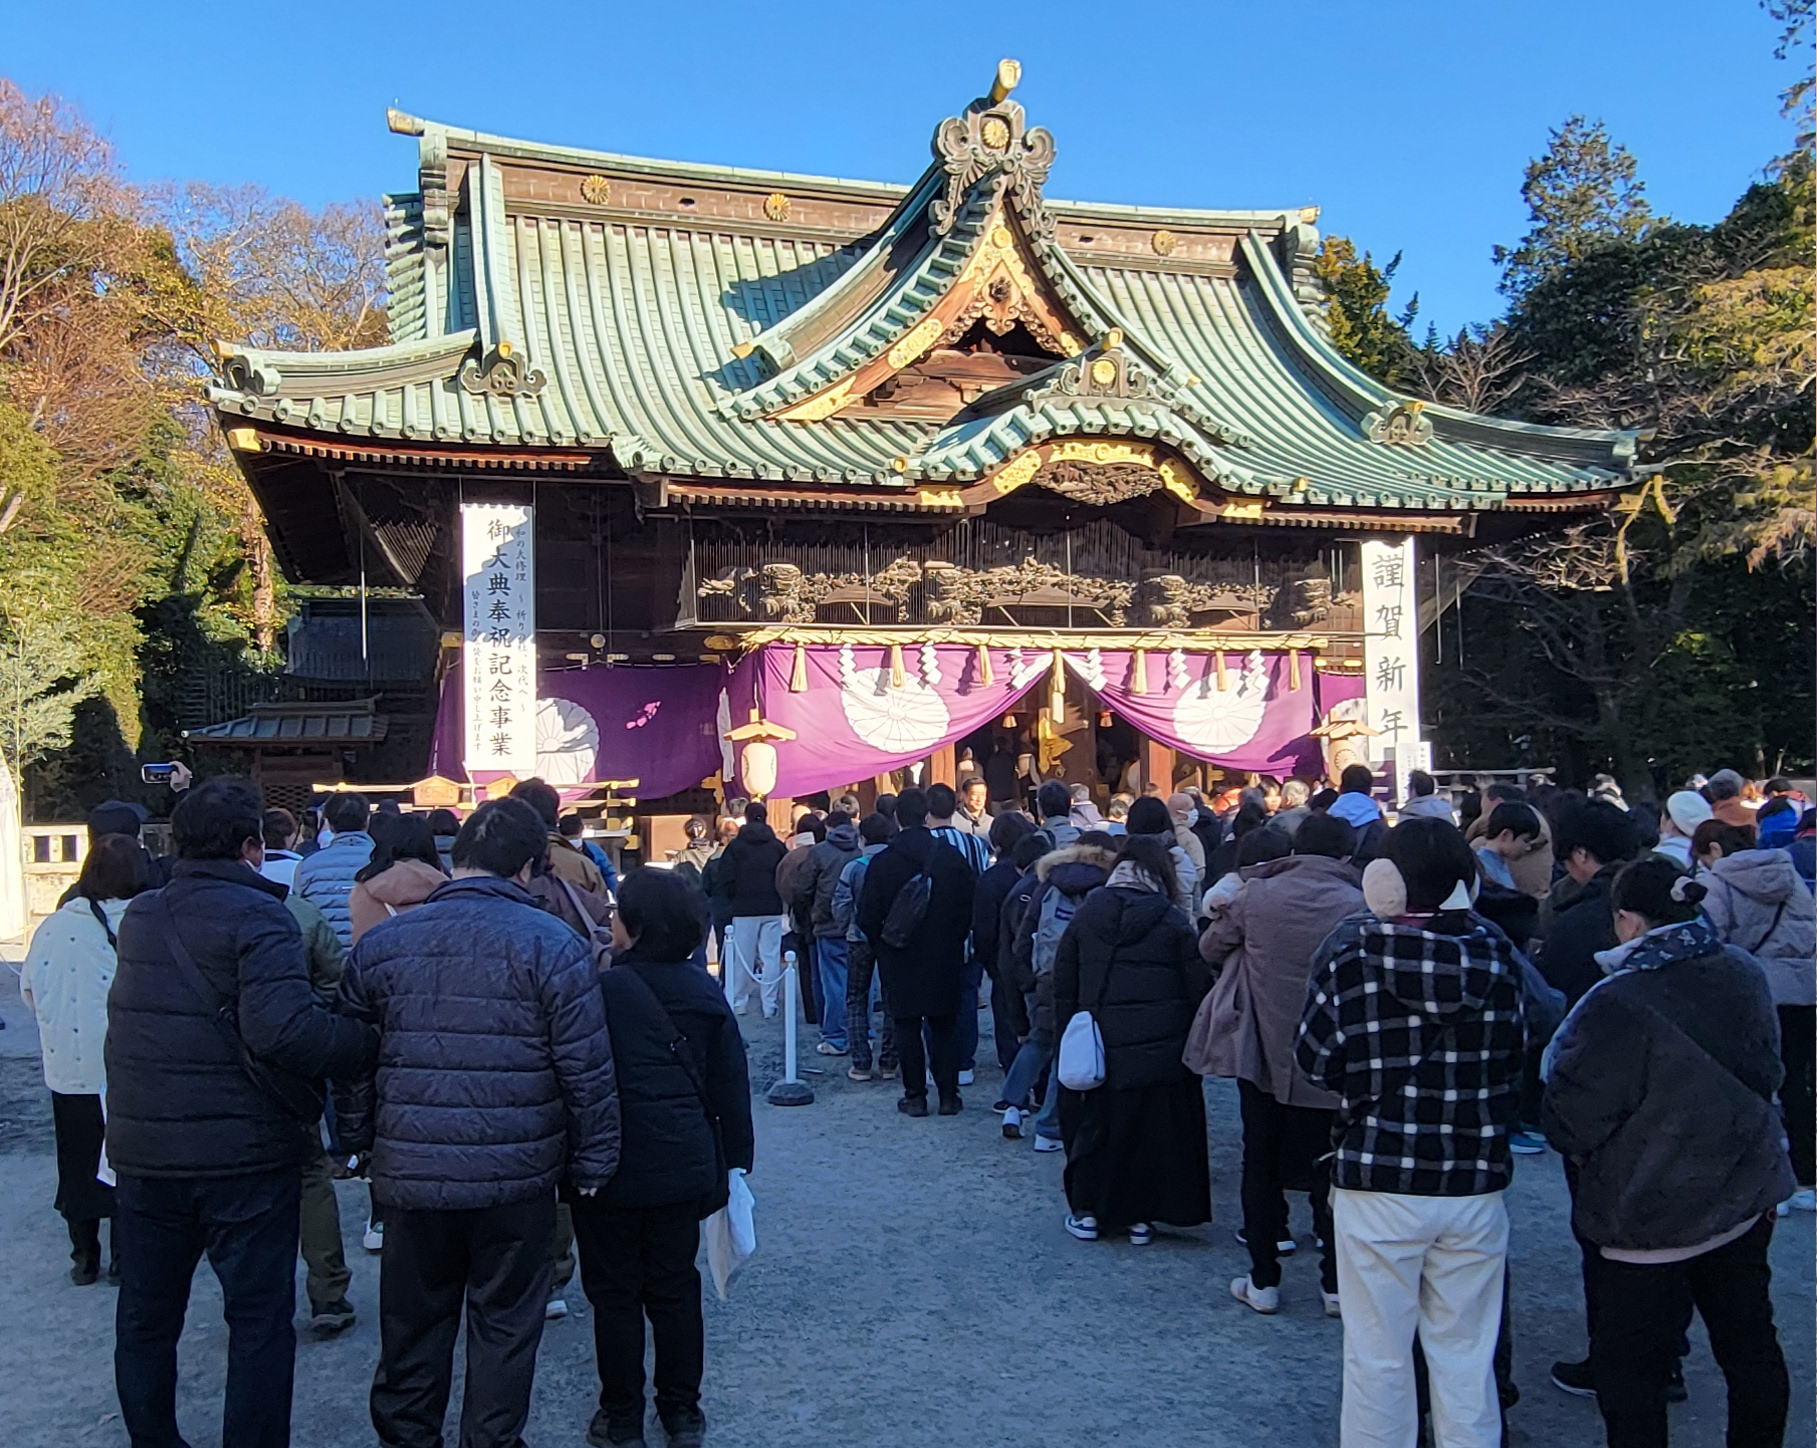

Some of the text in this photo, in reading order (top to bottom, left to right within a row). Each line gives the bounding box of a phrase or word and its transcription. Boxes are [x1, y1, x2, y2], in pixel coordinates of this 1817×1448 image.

[486, 518, 513, 757] 御大典奉祝記念事業
[514, 515, 527, 582] 和の大修理
[1371, 554, 1409, 742] 謹賀新年
